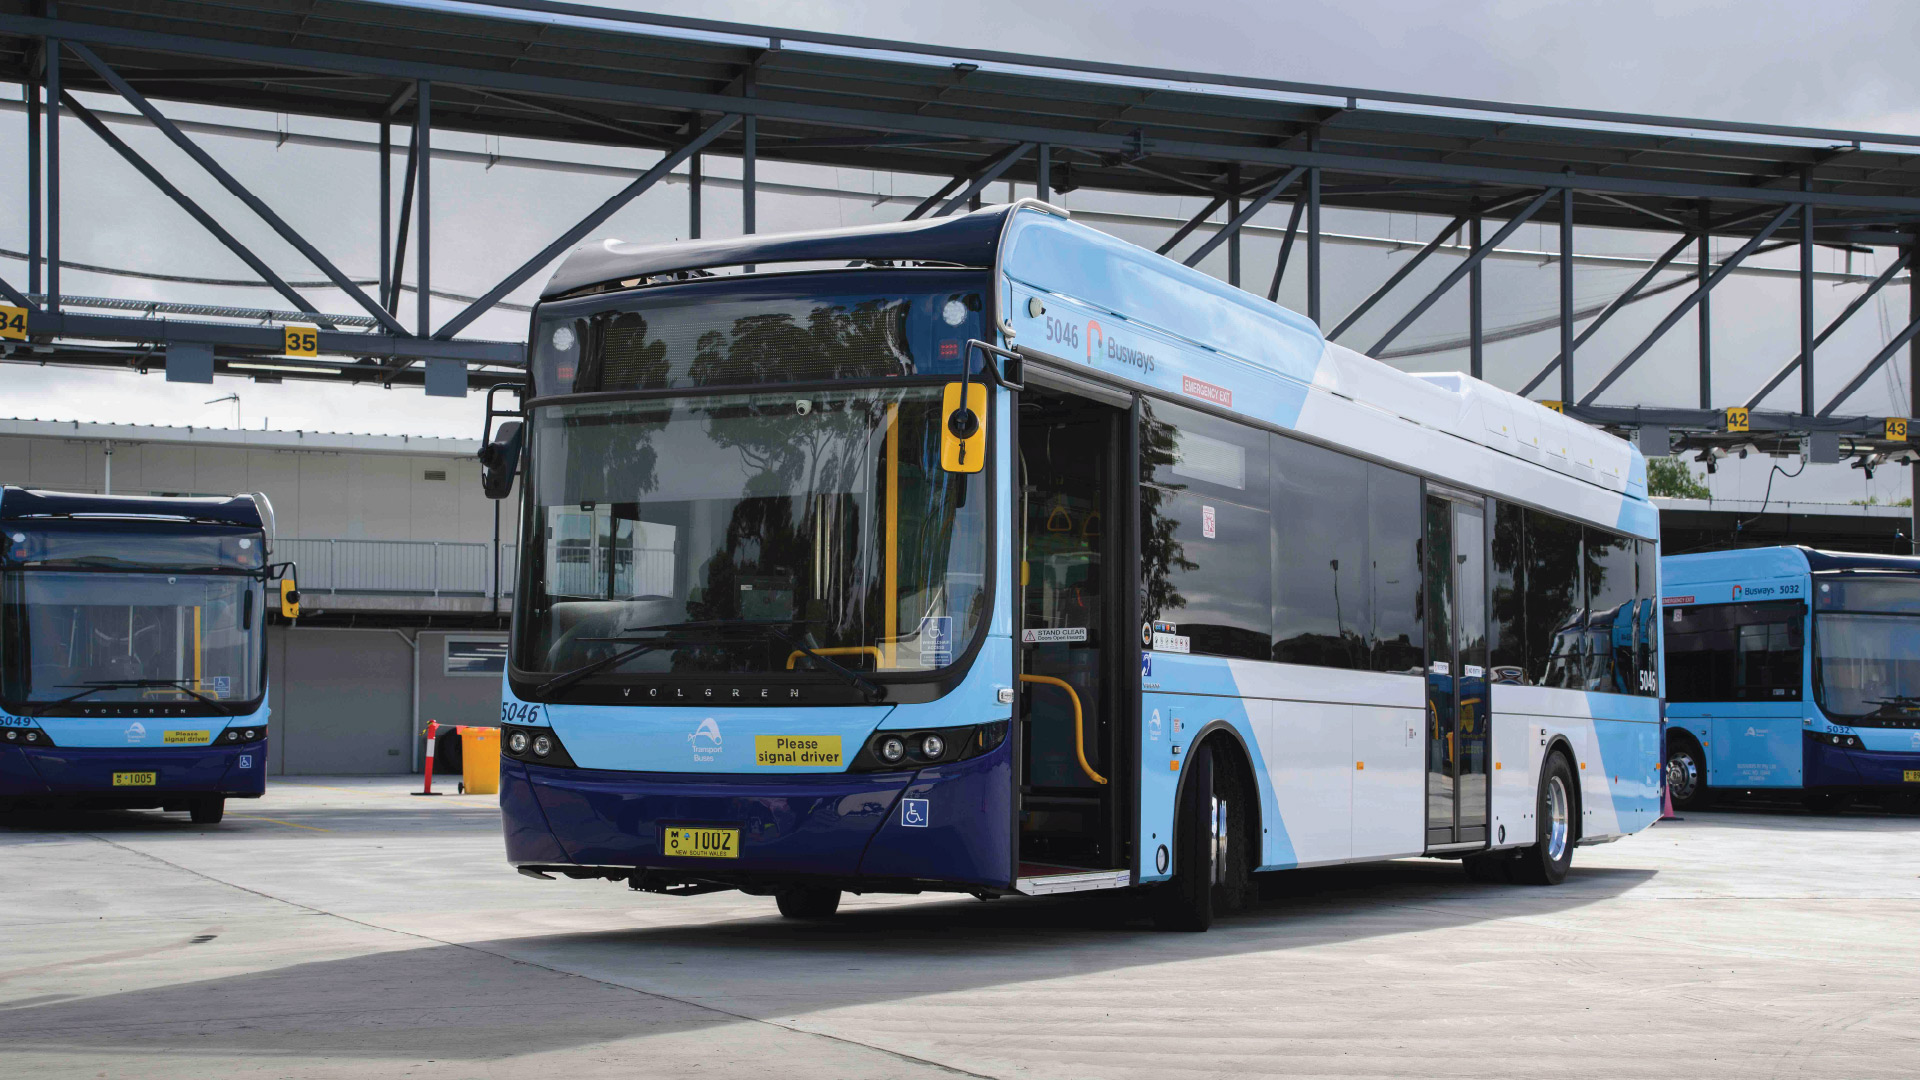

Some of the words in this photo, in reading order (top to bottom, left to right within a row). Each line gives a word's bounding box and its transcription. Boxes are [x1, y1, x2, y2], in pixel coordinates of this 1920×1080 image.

[1046, 316, 1079, 349] 5046
[287, 333, 316, 351] 35
[1107, 336, 1155, 375] Busways
[1184, 379, 1219, 400] EMERGENCY
[1219, 390, 1230, 403] EXIT
[1728, 412, 1748, 427] 42
[1887, 422, 1907, 436] 43
[1744, 586, 1775, 596] Busways
[1779, 584, 1800, 594] 5032
[1639, 669, 1656, 692] 5046
[623, 688, 800, 698] VOLGREN
[501, 702, 540, 724] 5046
[0, 716, 31, 726] 5049
[1826, 725, 1850, 734] 5032
[692, 745, 723, 753] Transport
[777, 738, 818, 749] Please
[694, 754, 714, 762] Buses
[758, 752, 797, 764] signal
[801, 752, 839, 763] driver
[130, 774, 152, 783] 1005
